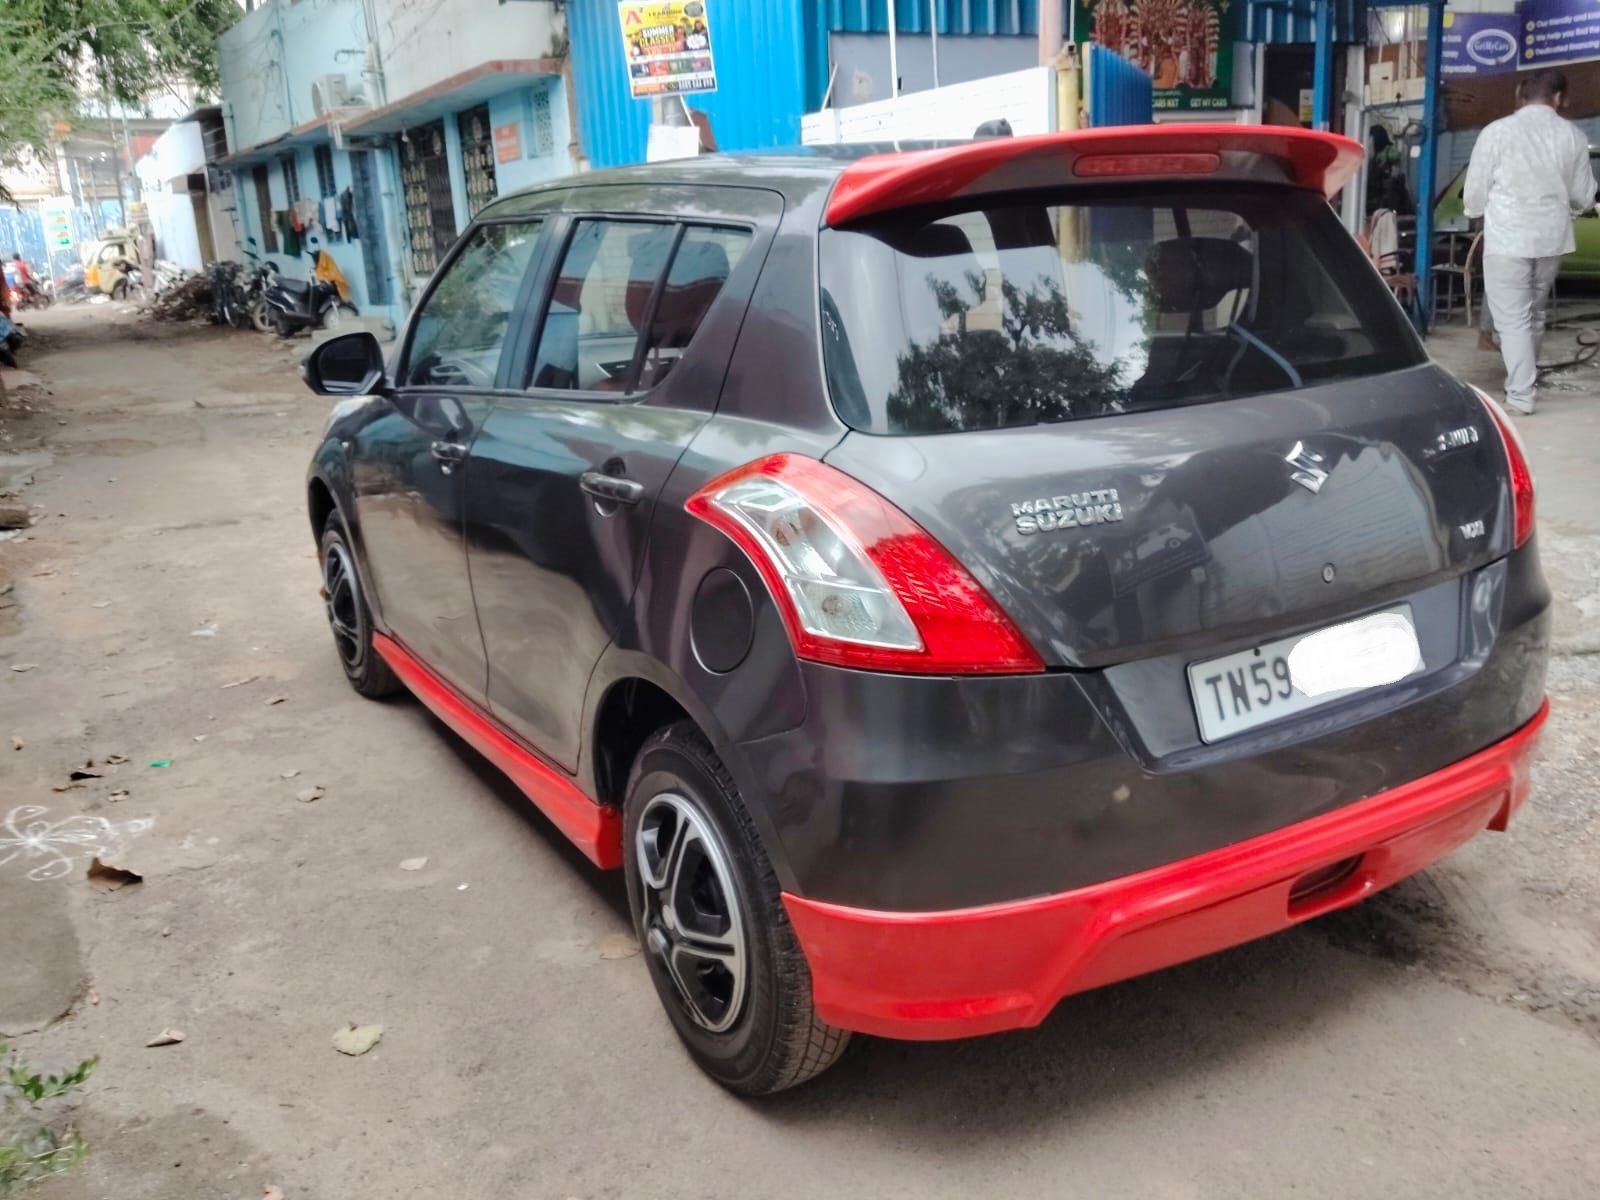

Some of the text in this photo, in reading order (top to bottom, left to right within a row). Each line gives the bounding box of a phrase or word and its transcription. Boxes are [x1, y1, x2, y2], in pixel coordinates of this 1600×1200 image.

[641, 25, 675, 39] SUMMER
[1189, 98, 1202, 108] GET
[1010, 488, 1120, 517] MARUTI
[1015, 502, 1124, 535] SUZUKI
[1205, 655, 1293, 721] TN59
